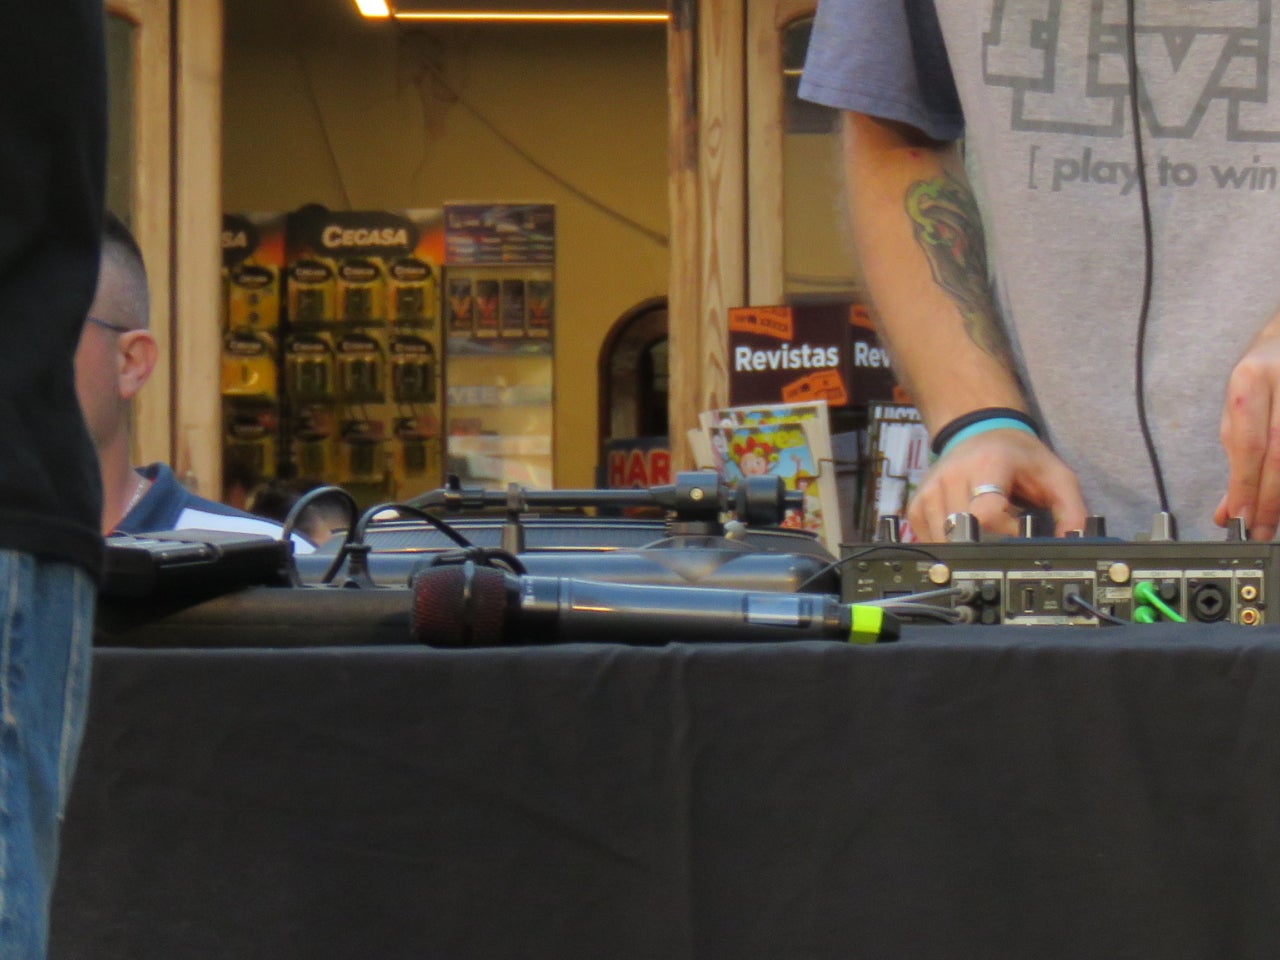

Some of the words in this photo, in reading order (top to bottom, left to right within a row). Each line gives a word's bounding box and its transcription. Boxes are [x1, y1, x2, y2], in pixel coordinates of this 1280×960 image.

[1157, 155, 1198, 187] to
[322, 225, 408, 248] CEGASA
[735, 344, 839, 372] Revistas
